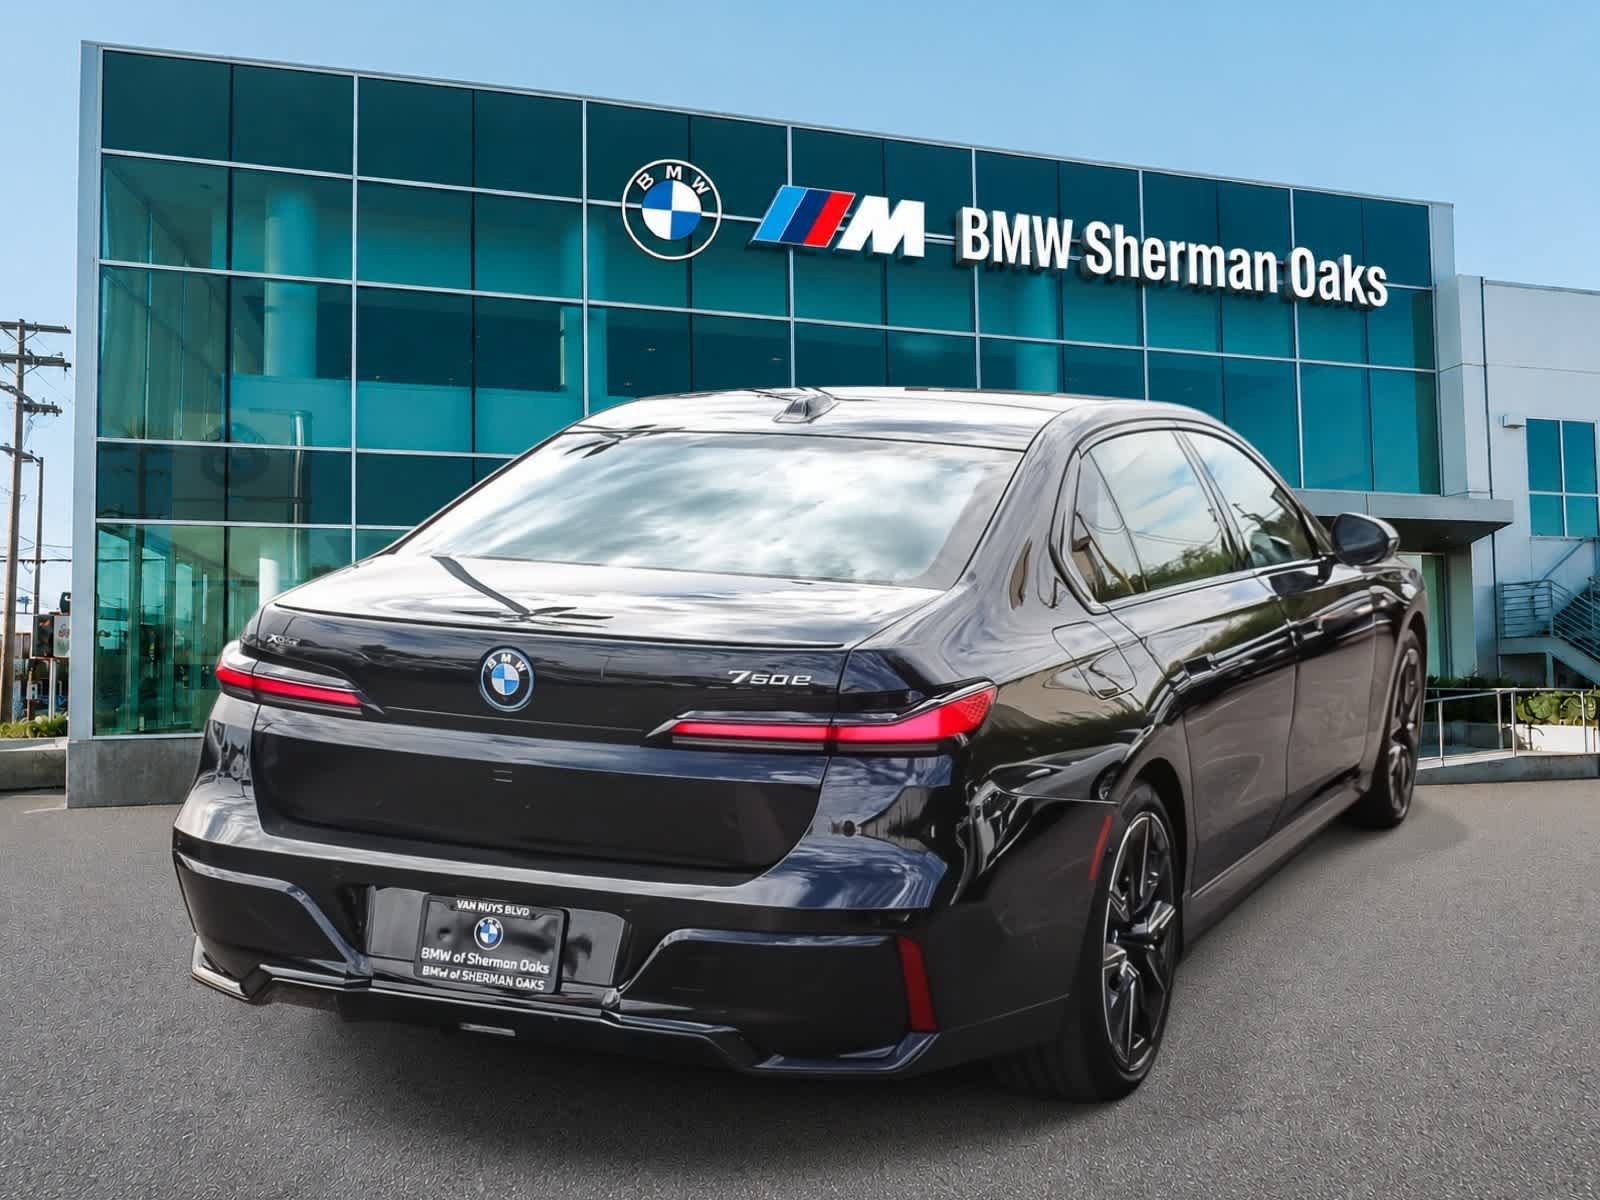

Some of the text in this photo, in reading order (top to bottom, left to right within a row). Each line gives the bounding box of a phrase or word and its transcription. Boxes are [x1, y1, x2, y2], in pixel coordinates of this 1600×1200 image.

[636, 165, 711, 196] BMW
[836, 195, 925, 257] M
[960, 206, 1388, 308] BMW Sherman Oaks
[728, 670, 812, 686] 750e
[456, 899, 530, 916] VAN NUYS BLVD
[421, 947, 550, 974] BMW of Sherman Oaks
[422, 965, 545, 991] BMW of SHERMAN OAKS
